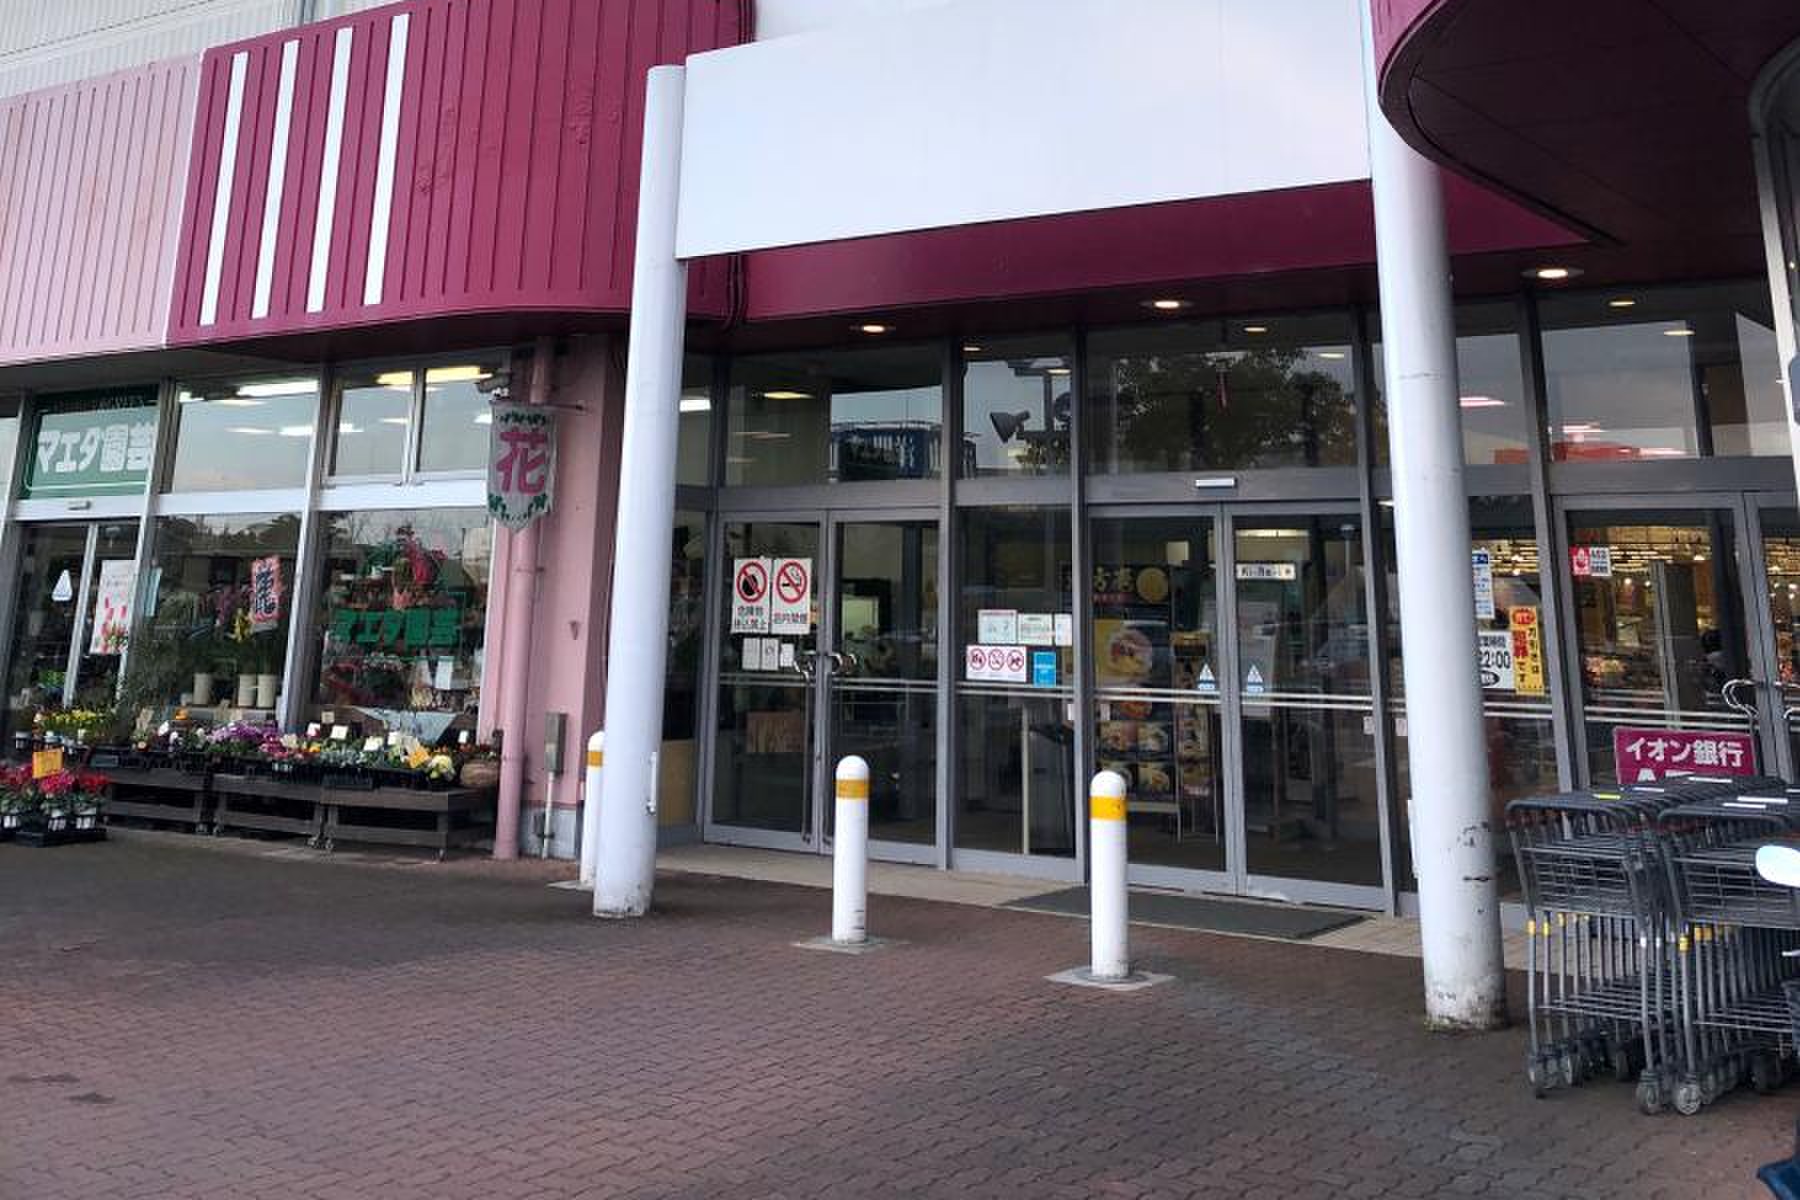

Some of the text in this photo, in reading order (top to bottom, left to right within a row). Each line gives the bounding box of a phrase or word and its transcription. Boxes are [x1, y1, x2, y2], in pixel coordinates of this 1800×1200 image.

[496, 425, 546, 496] 花
[1625, 736, 1744, 768] イオン銀行
